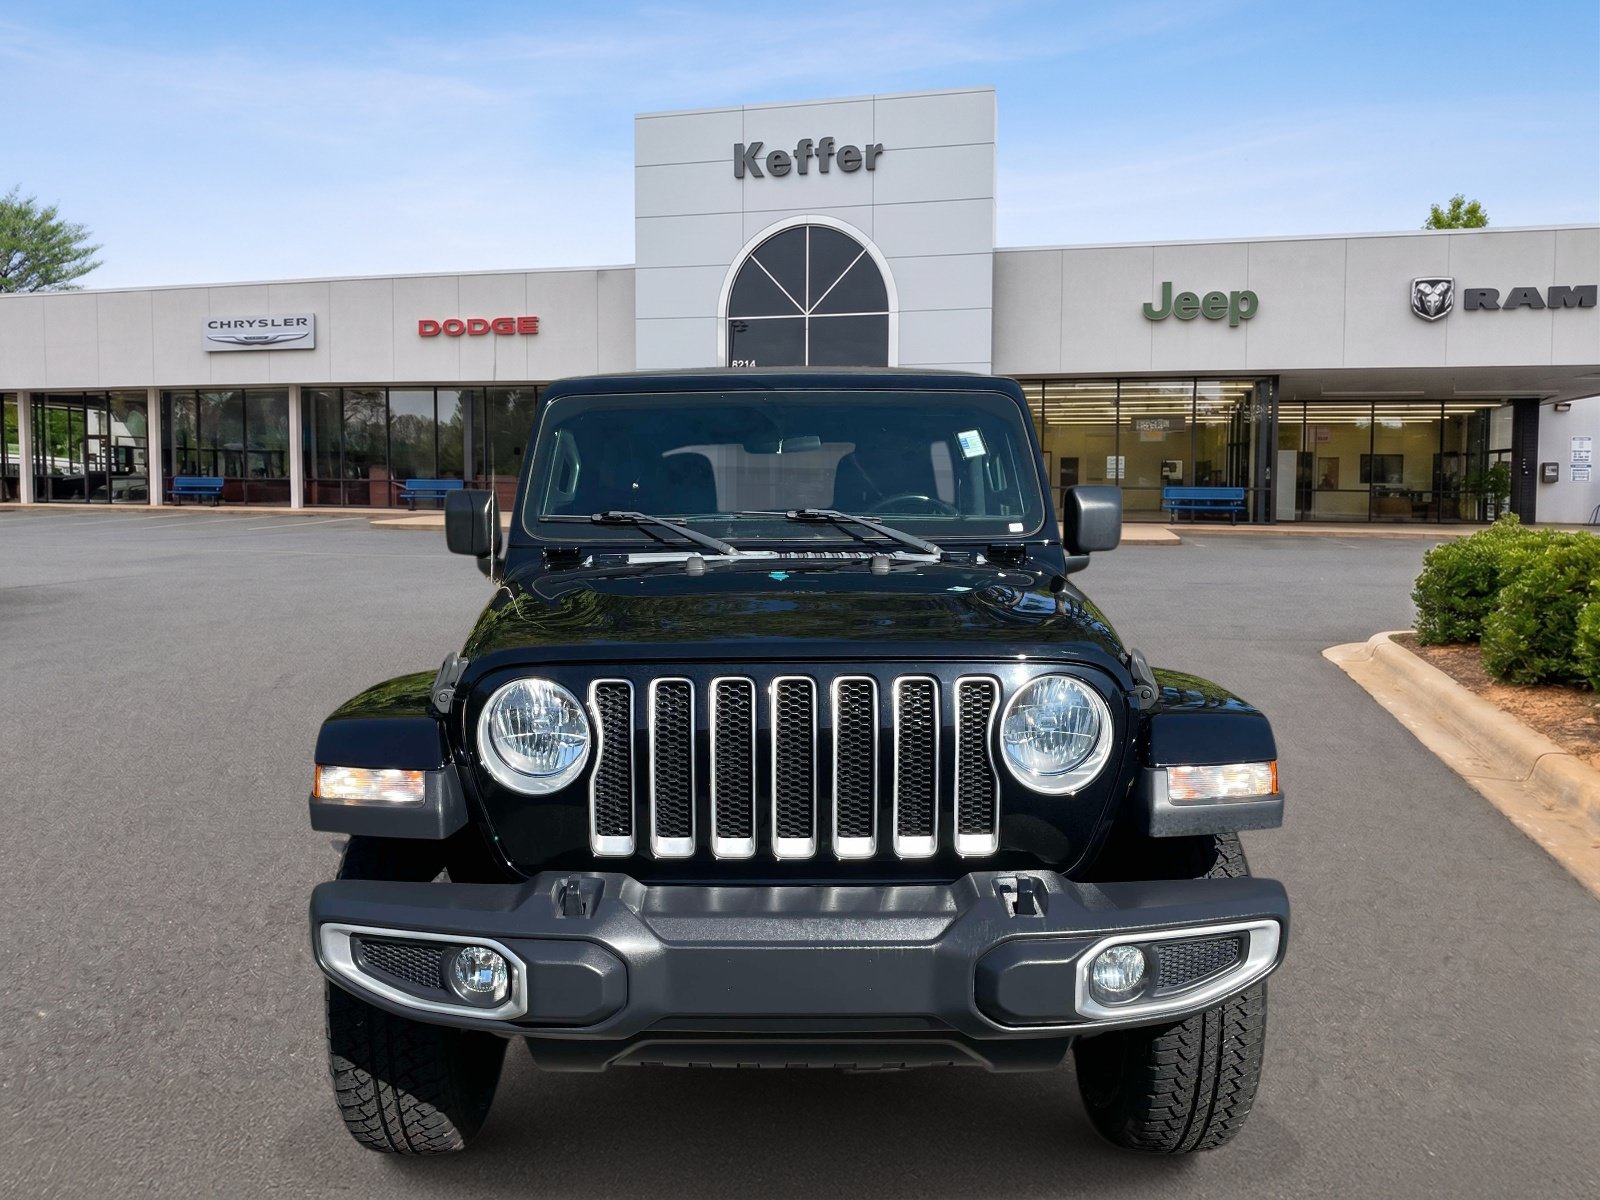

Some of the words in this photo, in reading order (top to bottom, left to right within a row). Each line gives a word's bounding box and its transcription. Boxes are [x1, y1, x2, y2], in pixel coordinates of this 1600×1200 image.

[733, 136, 883, 179] Keffer
[1143, 281, 1259, 327] Jeep
[1464, 285, 1597, 310] RAM
[208, 318, 307, 329] CHRYSLER
[418, 316, 539, 337] DODGE
